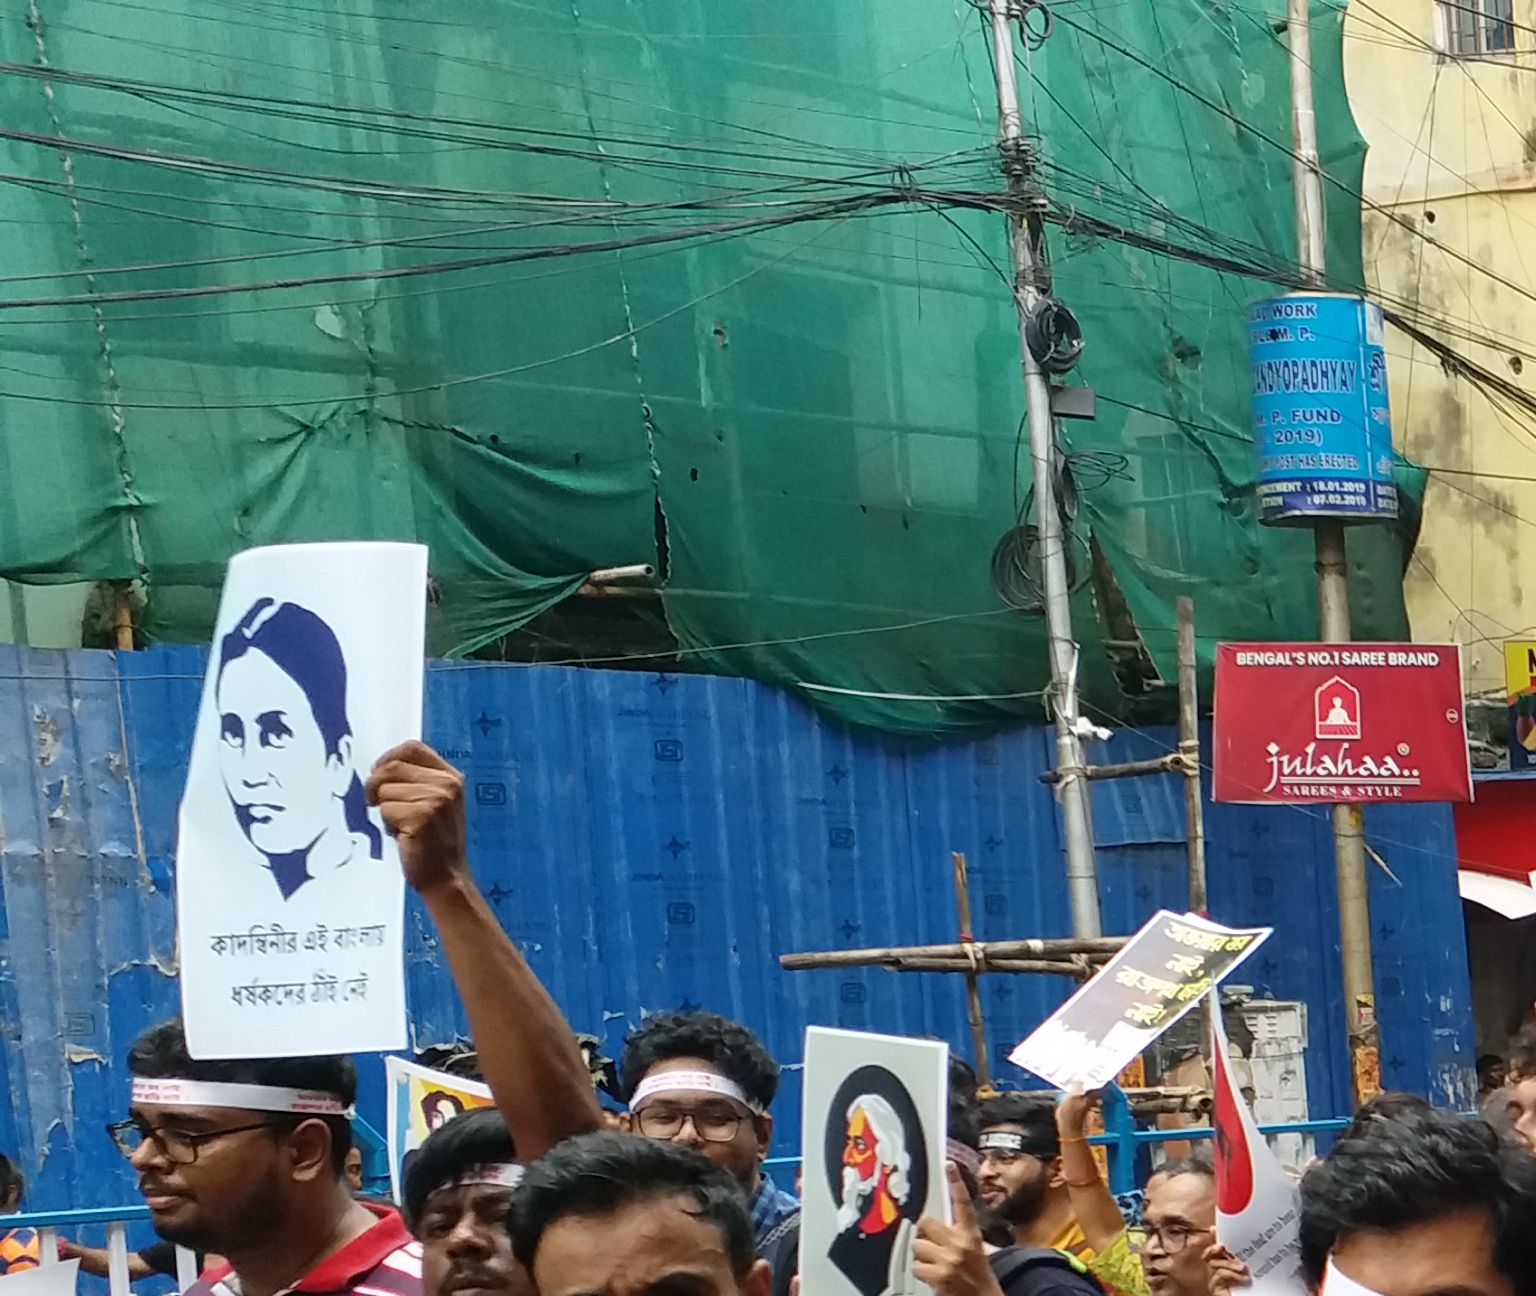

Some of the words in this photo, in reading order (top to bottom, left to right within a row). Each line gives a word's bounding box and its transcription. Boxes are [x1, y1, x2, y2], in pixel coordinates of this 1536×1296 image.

[1273, 304, 1317, 318] WORK
[1253, 358, 1357, 395] ANDYOPADHYAY
[1291, 409, 1343, 425] FUND
[1236, 652, 1306, 667] BENGAL'S
[1308, 652, 1339, 666] NO.1
[1341, 652, 1387, 666] SAREE
[1388, 652, 1439, 667] BRAND
[1282, 786, 1337, 797] SAREES
[1341, 786, 1351, 797] &
[1356, 786, 1402, 797] STYLE
